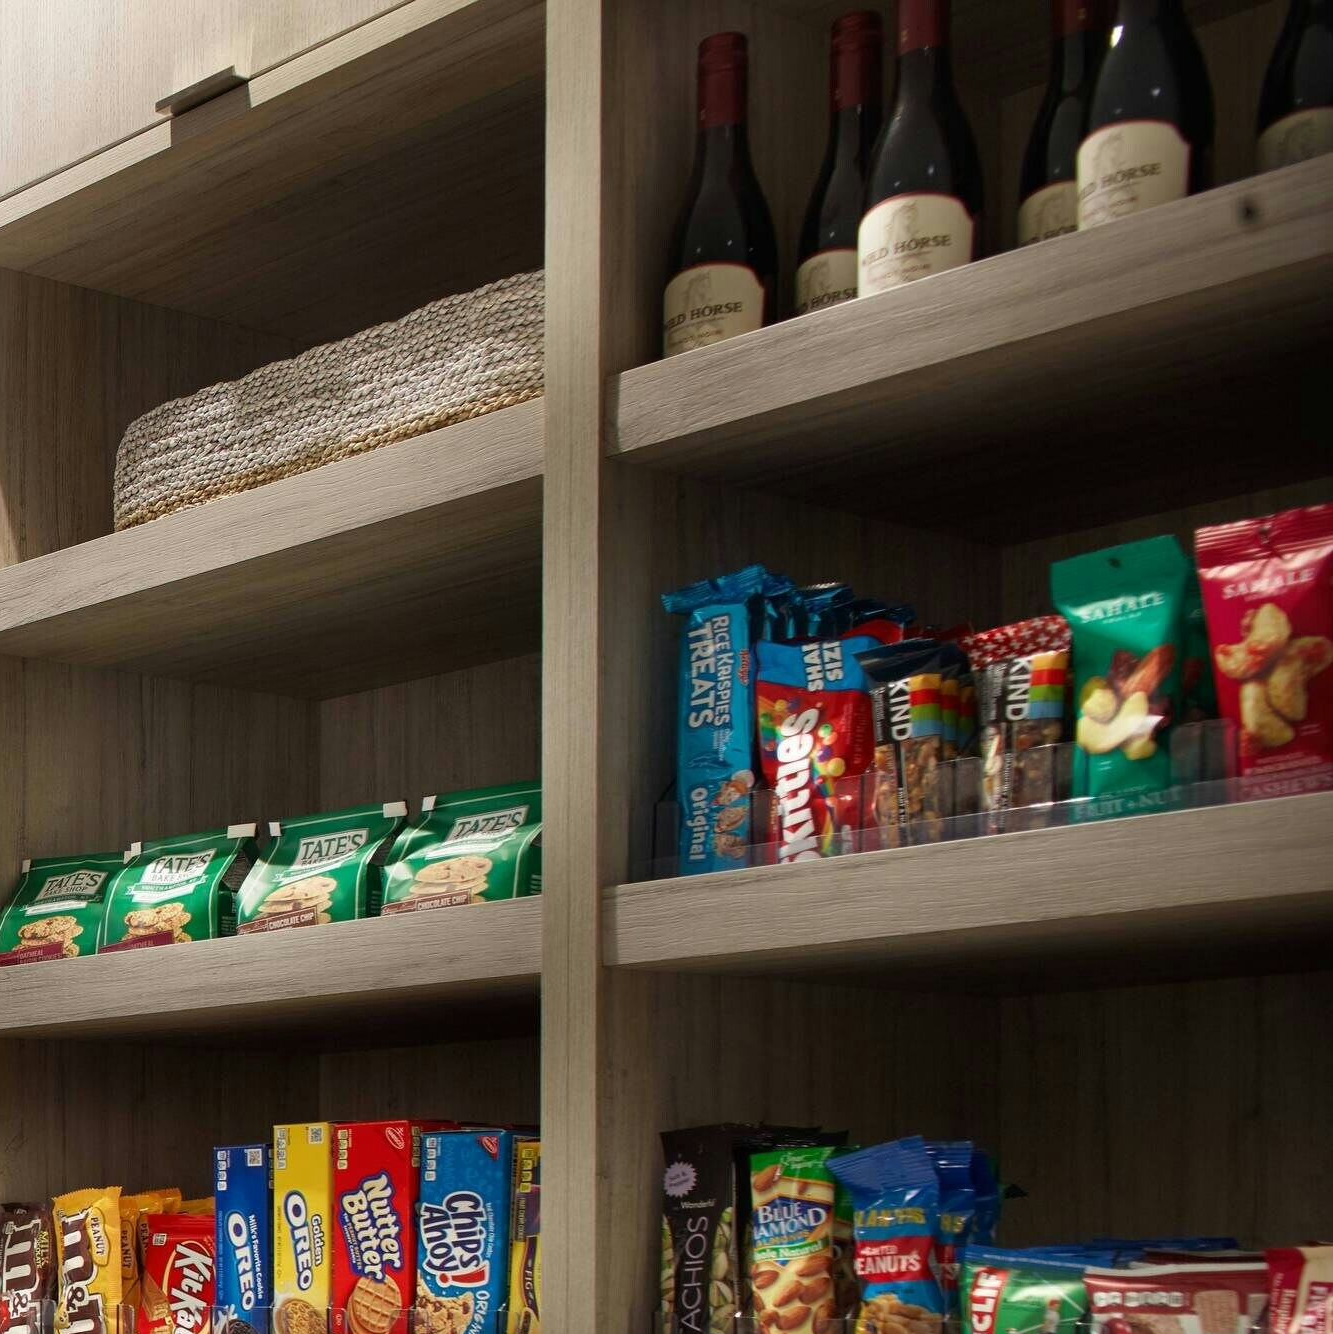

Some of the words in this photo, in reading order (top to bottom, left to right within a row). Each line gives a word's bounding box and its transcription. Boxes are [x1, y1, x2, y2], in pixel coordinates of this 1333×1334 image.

[1101, 162, 1161, 189] HORSE
[894, 235, 952, 252] HORSE
[690, 301, 743, 323] HORSE
[711, 615, 731, 652] RICE
[688, 621, 715, 728] TREATS
[713, 652, 734, 727] KRISPIES
[1005, 658, 1032, 721] KIND
[888, 677, 912, 741] KIND
[456, 812, 524, 838] TATE'S
[152, 853, 211, 874] TATE'S
[301, 834, 364, 860] TATE'S
[44, 872, 102, 893] TATE'S
[268, 915, 300, 930] CHOCOLATE
[300, 912, 315, 923] CHIP
[417, 897, 451, 911] CHOCOLATE
[451, 894, 468, 905] CHIP
[362, 1172, 403, 1271] Nutter
[758, 1202, 801, 1225] BLUE
[89, 1216, 106, 1256] PEANUT
[121, 1229, 134, 1270] PEANUT
[283, 1190, 313, 1291] OREO
[311, 1213, 323, 1266] Golden
[341, 1191, 383, 1283] Butter
[226, 1212, 255, 1312] OREO
